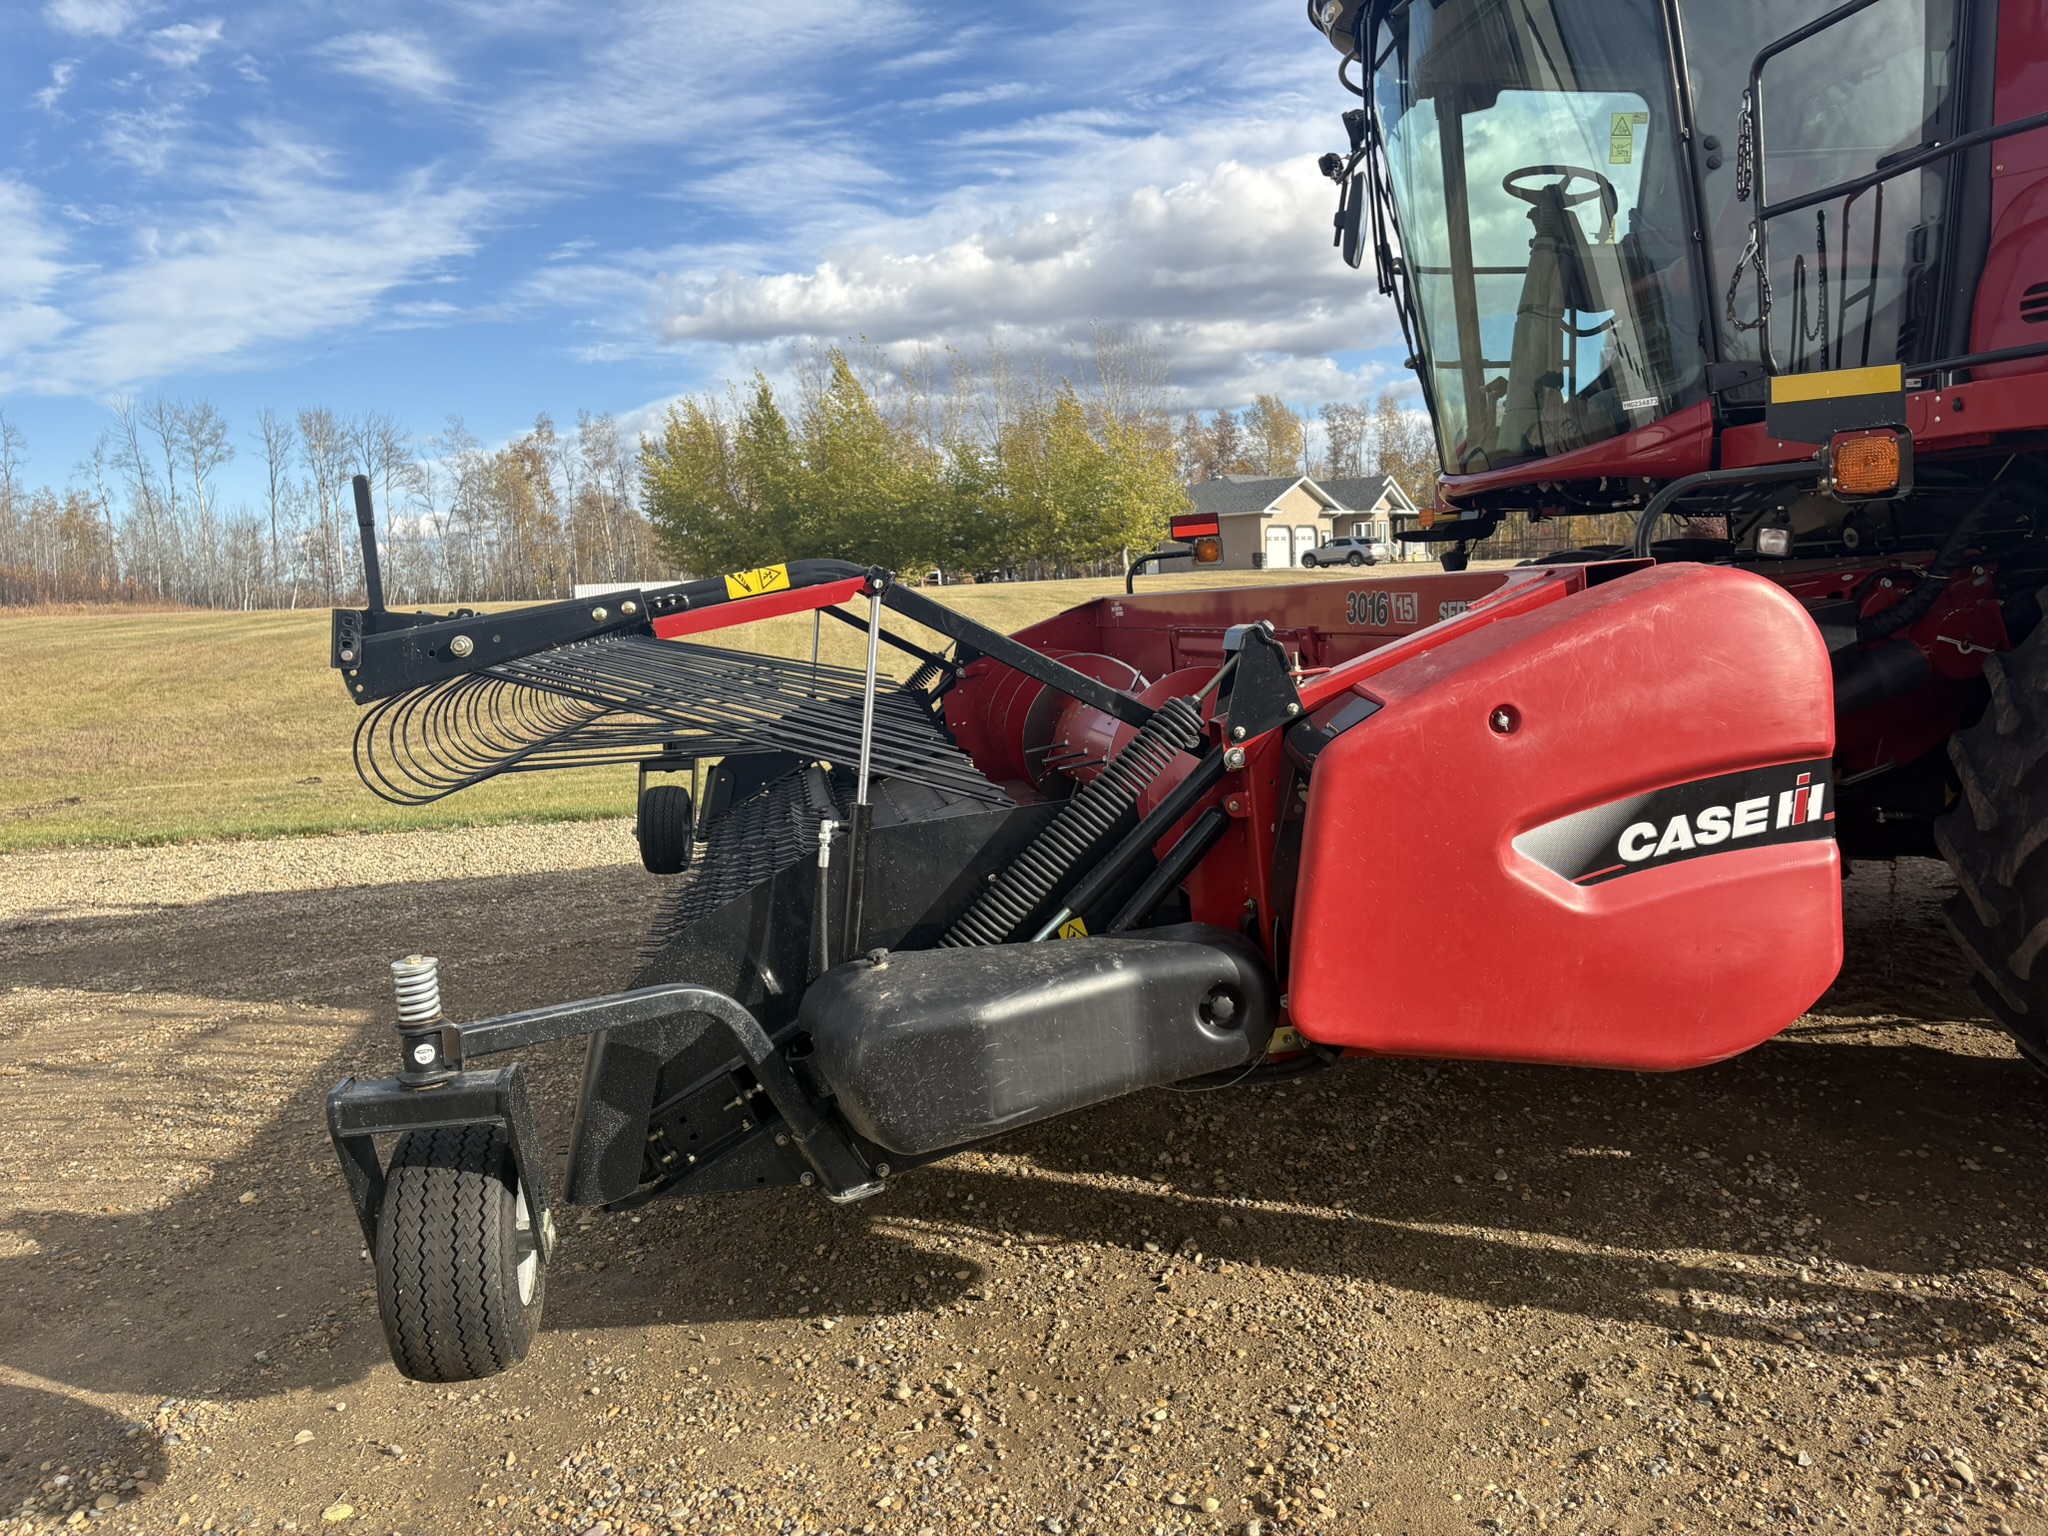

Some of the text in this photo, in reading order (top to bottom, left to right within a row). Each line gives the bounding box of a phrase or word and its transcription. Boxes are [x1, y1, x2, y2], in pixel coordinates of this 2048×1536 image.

[1346, 591, 1388, 626] 3016
[1397, 597, 1413, 620] 15
[1618, 796, 1770, 862] CASE
